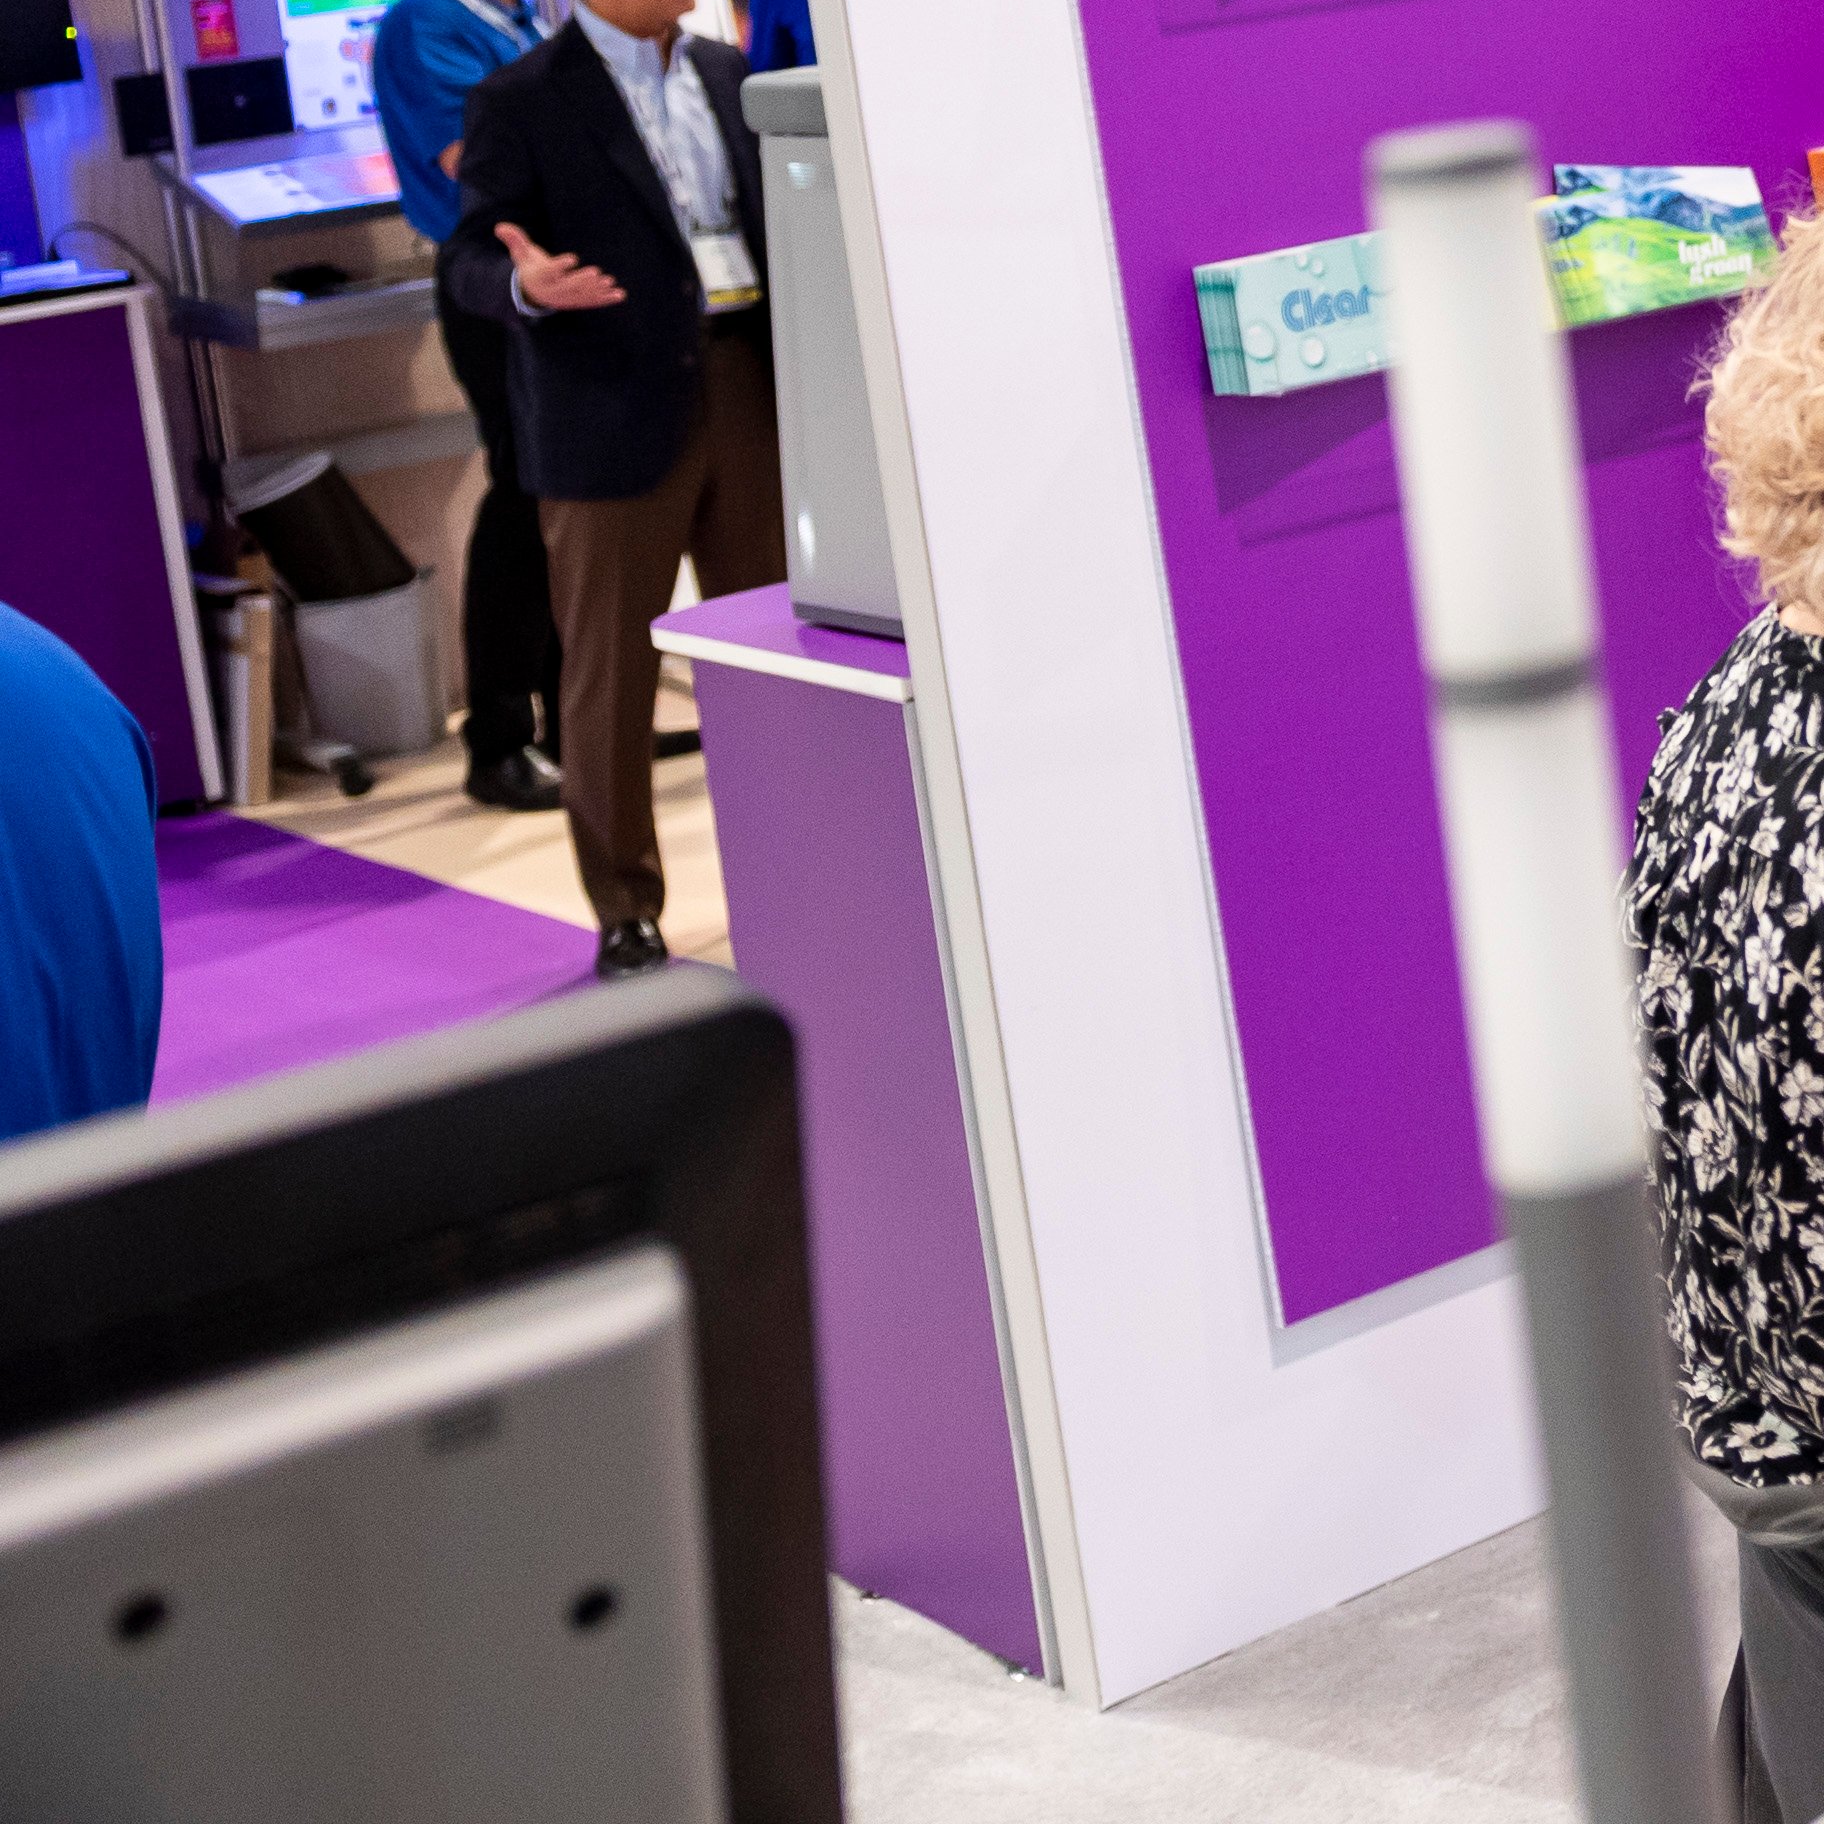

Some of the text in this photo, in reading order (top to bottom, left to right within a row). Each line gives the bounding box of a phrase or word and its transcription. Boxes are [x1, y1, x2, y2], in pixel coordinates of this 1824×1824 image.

[1677, 235, 1728, 262] lush
[1688, 253, 1754, 286] green
[1280, 284, 1371, 333] Clear
